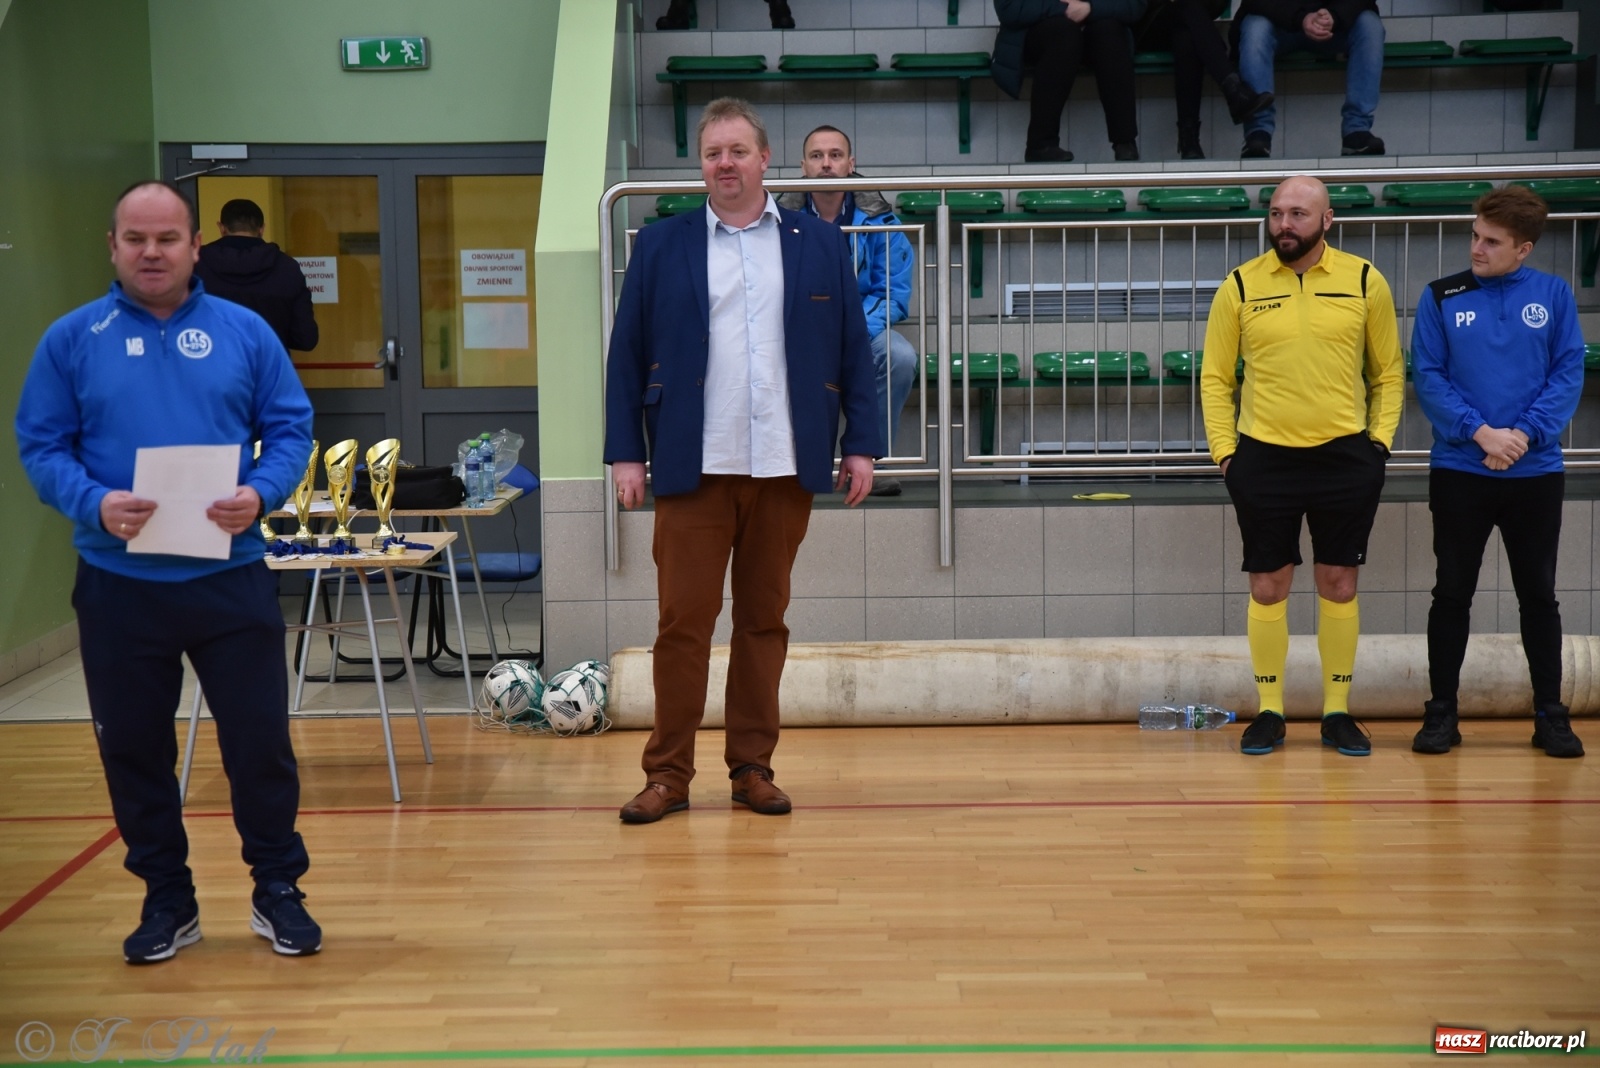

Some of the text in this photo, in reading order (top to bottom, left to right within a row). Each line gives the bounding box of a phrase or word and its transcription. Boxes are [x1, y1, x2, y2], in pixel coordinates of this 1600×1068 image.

[476, 277, 513, 286] ZMIENNE
[1455, 310, 1476, 328] PP
[1526, 305, 1544, 319] LKS
[126, 337, 145, 356] MB
[181, 331, 207, 349] LKS
